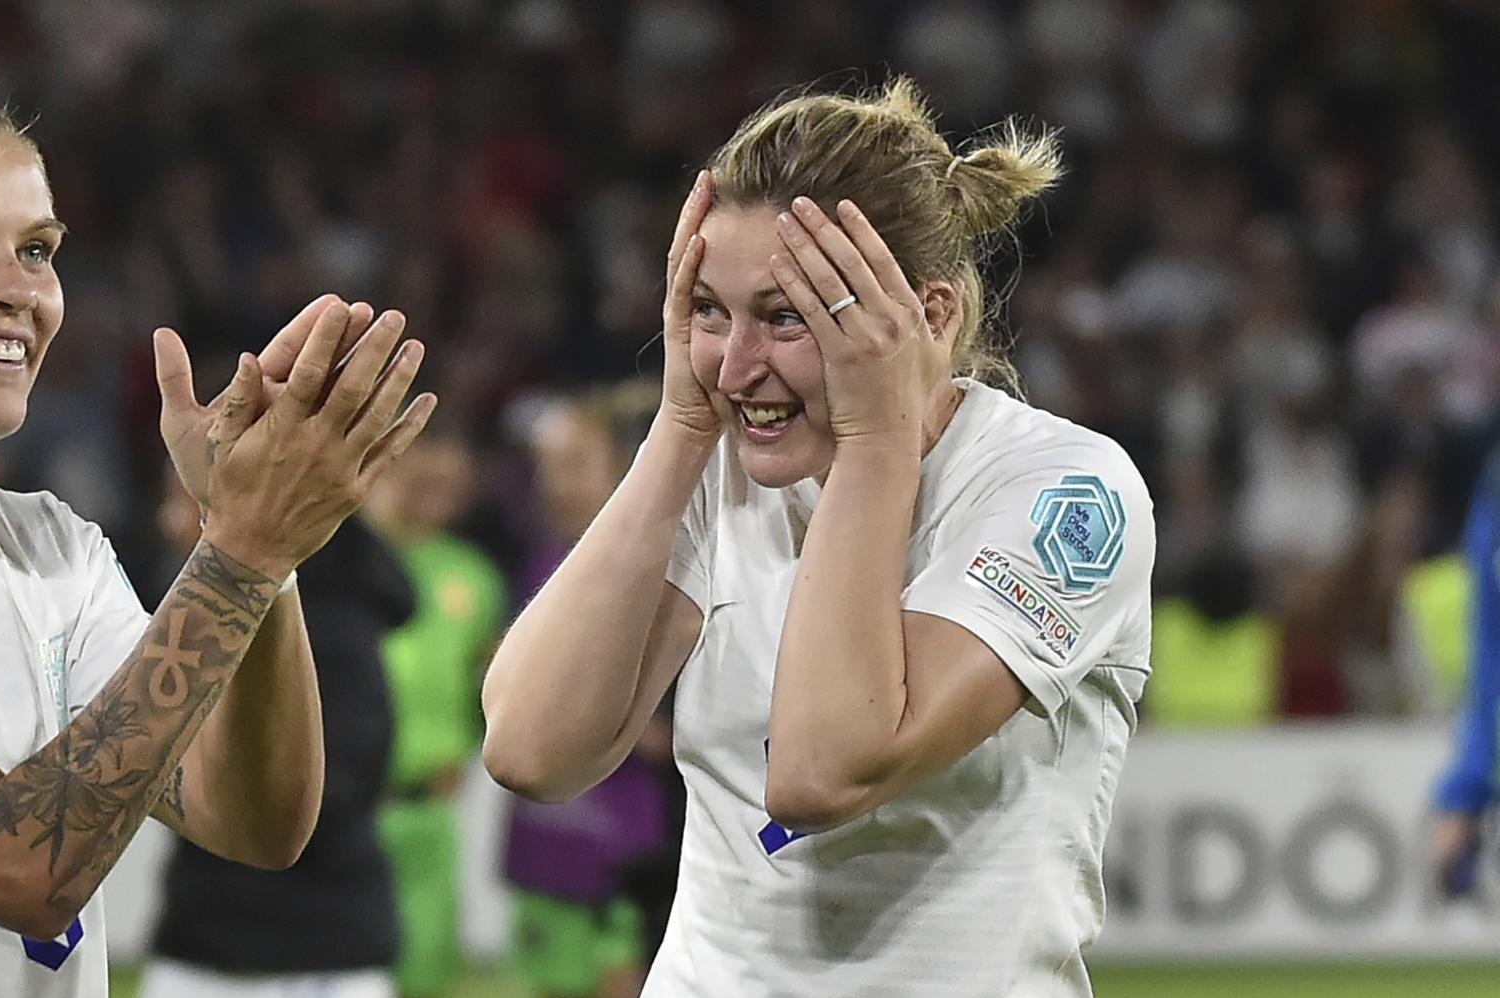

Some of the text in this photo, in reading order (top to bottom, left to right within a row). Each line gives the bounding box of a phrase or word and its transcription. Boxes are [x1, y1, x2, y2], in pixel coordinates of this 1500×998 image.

[1074, 503, 1090, 522] We
[980, 546, 1011, 570] UEFA
[968, 556, 1077, 650] FOUNDATION
